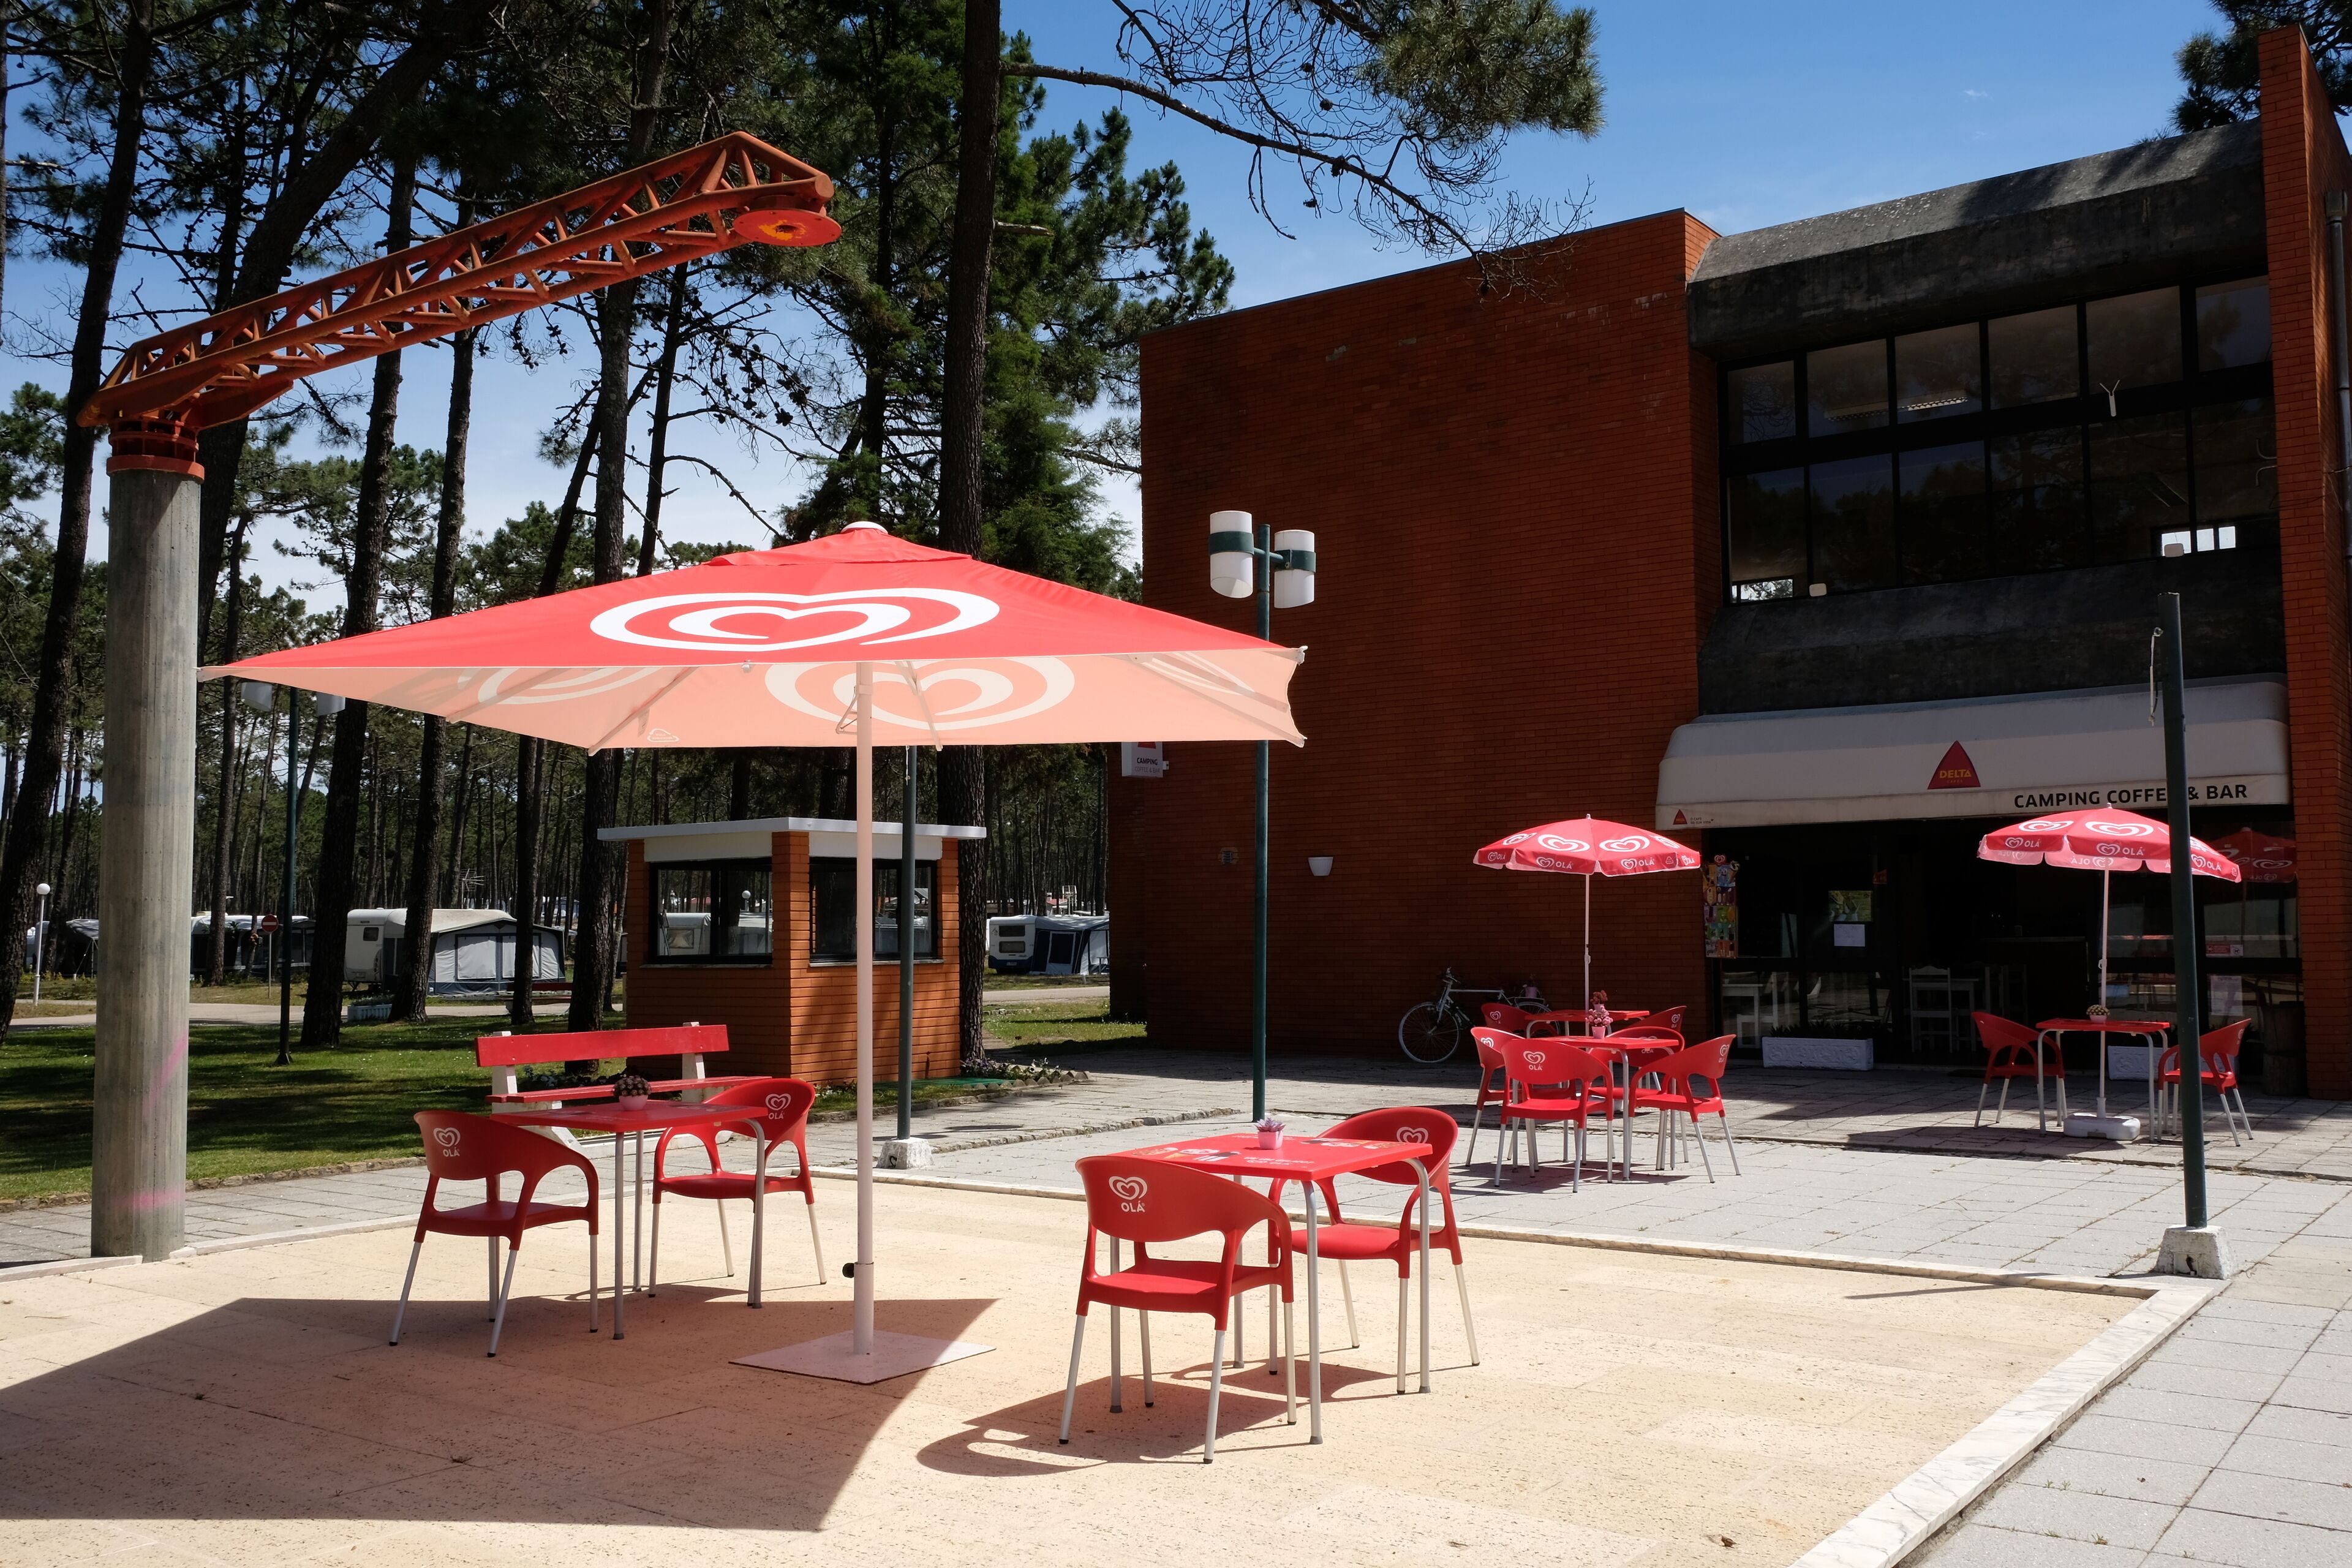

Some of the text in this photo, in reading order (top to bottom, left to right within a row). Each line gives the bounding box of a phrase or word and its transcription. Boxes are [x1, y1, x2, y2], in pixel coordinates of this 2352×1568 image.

[1137, 757, 1158, 766] CAMPING
[1939, 769, 1972, 778] DELTA
[2014, 784, 2248, 808] CAMPING COFFE & BAR
[2024, 839, 2040, 848] OLÁ
[2122, 846, 2144, 856] OLÁ
[1638, 857, 1654, 867] OLÁ
[2207, 862, 2222, 871] OLÁ
[768, 1110, 784, 1120] OLÁ
[443, 1147, 460, 1157] OLÁ
[1121, 1200, 1145, 1212] OLÁ
